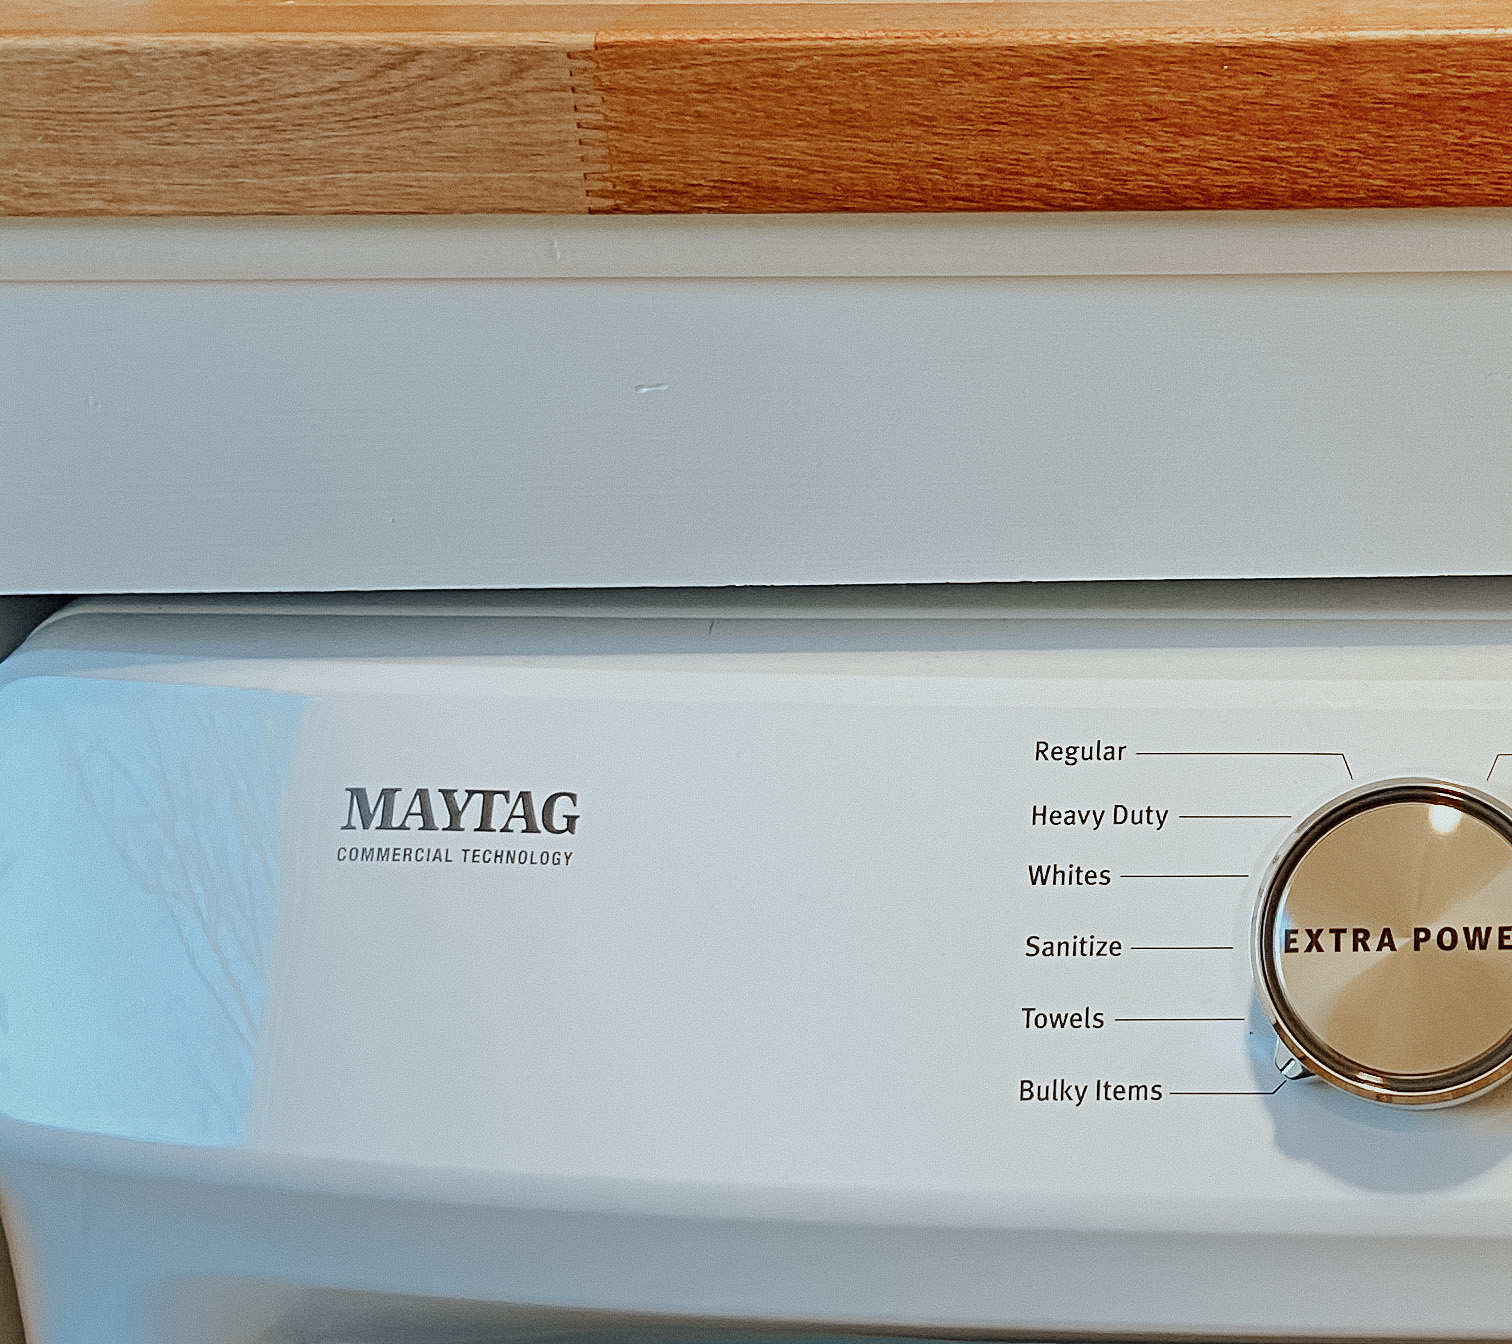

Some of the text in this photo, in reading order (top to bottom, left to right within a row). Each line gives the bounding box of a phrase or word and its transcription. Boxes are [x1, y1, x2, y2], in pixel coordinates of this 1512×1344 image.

[1036, 740, 1126, 766] Regular
[341, 788, 579, 834] MAYTAG
[1032, 805, 1168, 830] Heavy Duty
[337, 847, 572, 865] COMMERCIAL TECHNOLOGY
[1029, 864, 1110, 885] Whites
[1026, 935, 1121, 957] Sanitize
[1285, 928, 1396, 953] EXTRA
[1022, 1007, 1104, 1028] Towels
[1020, 1079, 1162, 1106] Bulky Items
